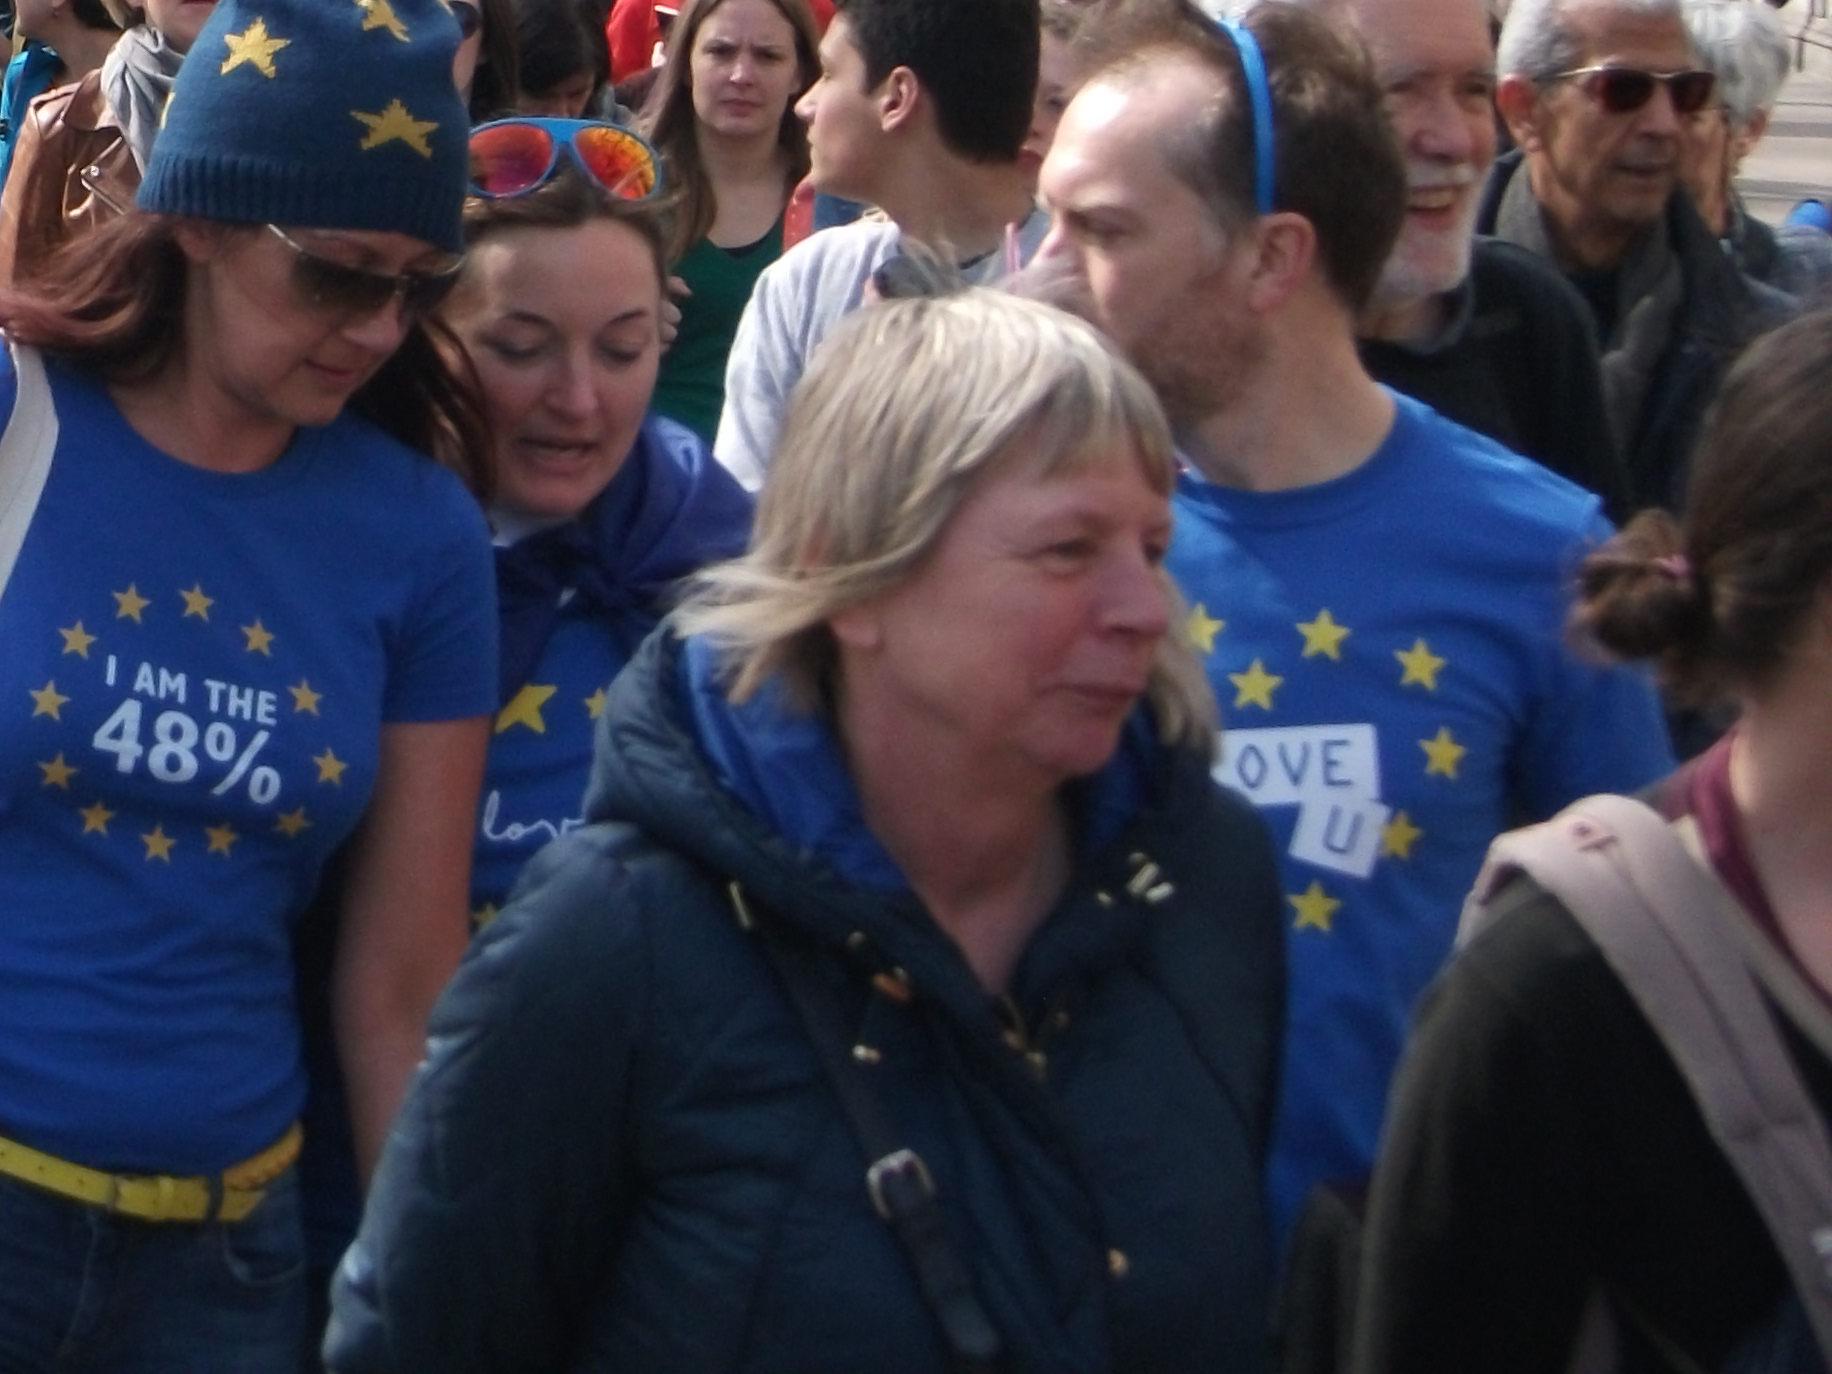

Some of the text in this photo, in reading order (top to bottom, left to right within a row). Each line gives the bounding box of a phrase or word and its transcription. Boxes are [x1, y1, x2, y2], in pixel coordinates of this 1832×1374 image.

[105, 654, 278, 726] I AM THE
[91, 698, 282, 805] 48%
[1236, 738, 1354, 790] OVE
